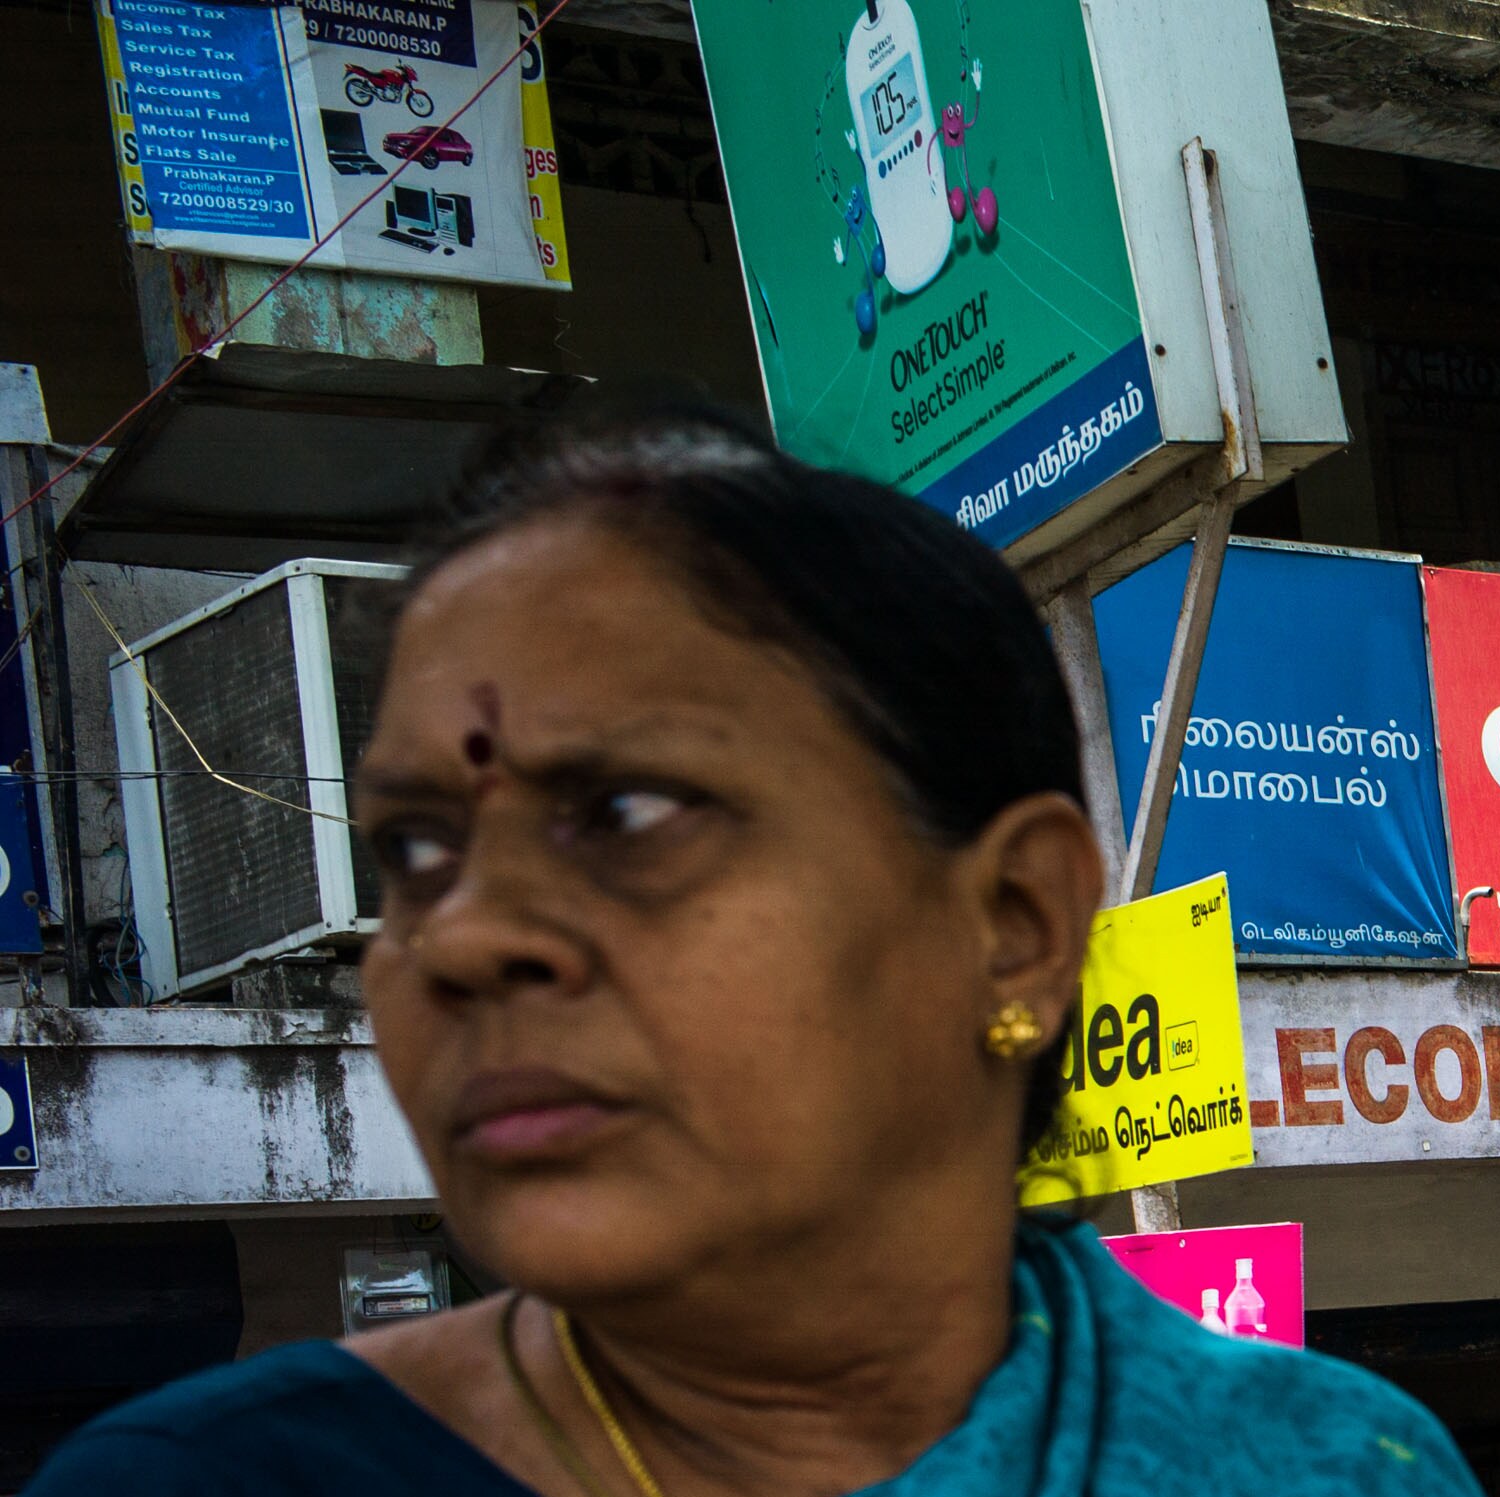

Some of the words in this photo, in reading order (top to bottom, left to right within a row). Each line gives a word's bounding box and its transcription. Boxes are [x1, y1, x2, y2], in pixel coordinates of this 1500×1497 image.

[193, 7, 226, 20] Tax
[121, 19, 173, 35] Sales
[180, 25, 213, 38] Tax
[125, 40, 197, 57] Service
[202, 47, 237, 61] Tax
[335, 24, 441, 57] 7200008530
[129, 61, 244, 82] Registration
[135, 82, 222, 100] Accounts
[138, 103, 200, 119] Mutual
[207, 109, 251, 123] Fund
[141, 124, 196, 139] Motor
[201, 127, 290, 148] Insurance
[145, 145, 192, 160] Flats
[197, 149, 237, 163] Sale
[163, 166, 275, 186] Prabhakaran.P
[179, 181, 223, 193] Certified
[225, 185, 264, 196] Advisor
[159, 192, 295, 214] 7200008529/30
[1012, 380, 1145, 497] மருந்தகம்
[1115, 1083, 1243, 1161] நெட்வொர்க்
